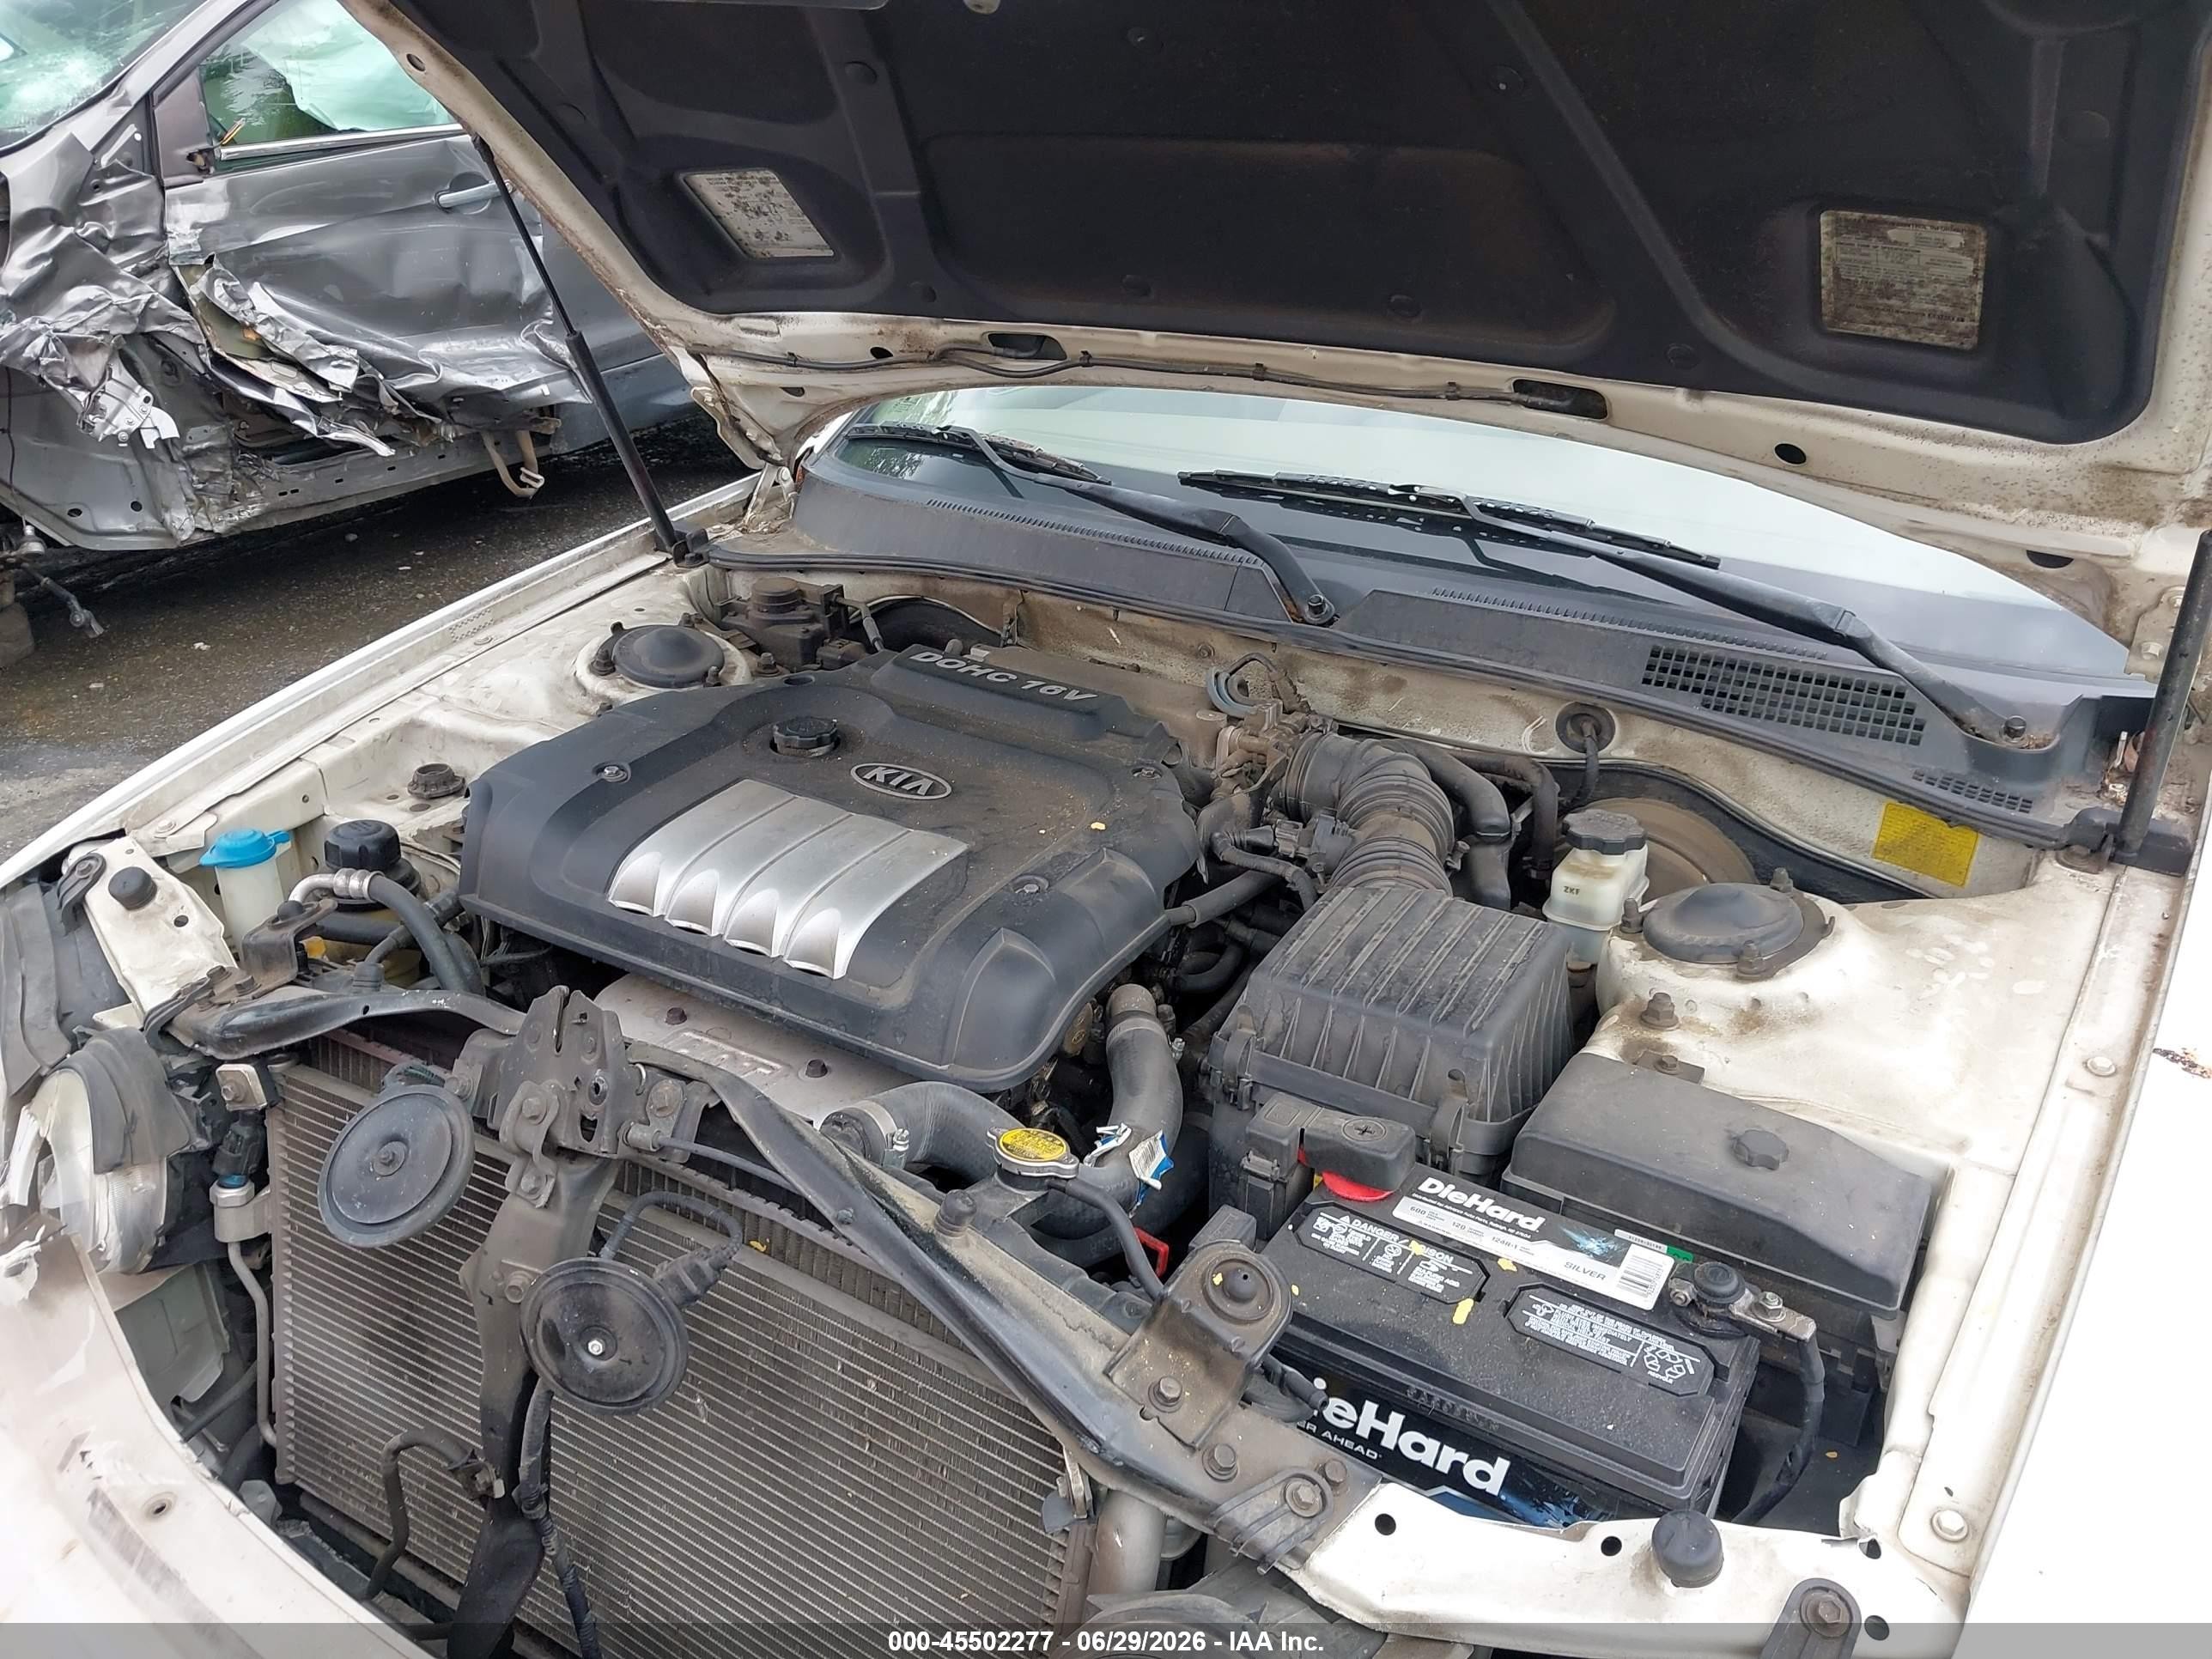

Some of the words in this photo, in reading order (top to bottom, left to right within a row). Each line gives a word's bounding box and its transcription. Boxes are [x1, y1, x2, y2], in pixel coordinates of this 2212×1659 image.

[908, 652, 1017, 683] DOHC
[1021, 680, 1098, 701] 16V
[862, 766, 935, 796] KIA
[1410, 1206, 1426, 1215] 600
[1452, 1221, 1466, 1230] 120
[1418, 1176, 1546, 1232] DieHard
[1443, 1205, 1464, 1214] Advance
[1564, 1261, 1607, 1280] SILVER
[1297, 1420, 1316, 1433] ER
[1321, 1430, 1378, 1460] AHEAD
[1313, 1377, 1510, 1497] eHard
